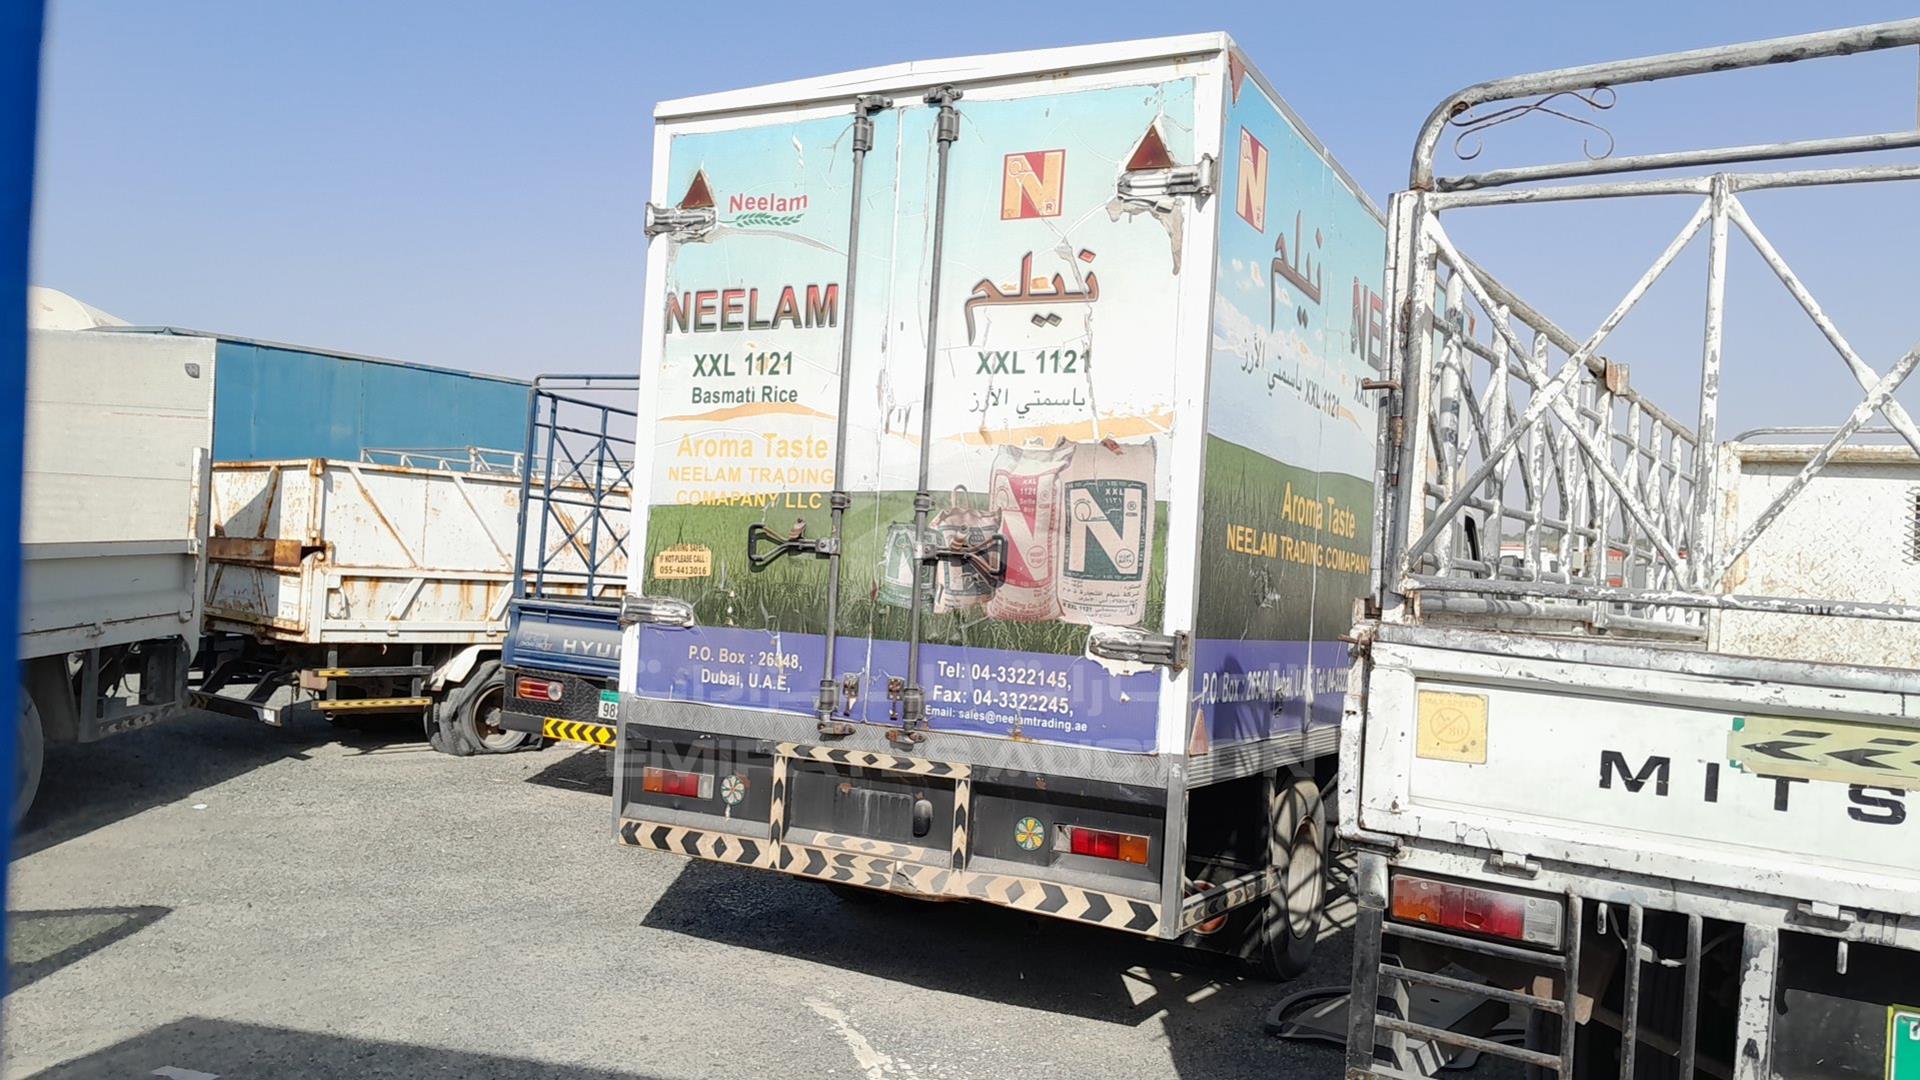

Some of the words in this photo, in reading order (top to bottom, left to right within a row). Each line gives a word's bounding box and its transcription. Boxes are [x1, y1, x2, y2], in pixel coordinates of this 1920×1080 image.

[729, 193, 808, 213] Neelam
[666, 283, 839, 334] NEELAM
[692, 353, 735, 377] XXL
[745, 351, 792, 375] 1121
[976, 351, 1025, 374] XXL
[1036, 349, 1090, 373] 1121
[692, 386, 755, 404] Basmati
[762, 386, 798, 403] Rice
[1016, 387, 1085, 419] باسمتي
[677, 434, 752, 459] Aroma
[763, 433, 828, 460] Taste
[669, 466, 741, 482] NEELAM
[749, 467, 834, 484] TRADING
[676, 490, 779, 507] COMAPANY
[785, 493, 822, 509] LLC
[1282, 481, 1323, 530] Aroma
[1327, 496, 1356, 539] Taste
[1227, 523, 1278, 558] NEELAM
[1280, 535, 1323, 567] TRADING
[1326, 546, 1371, 576] COMAPANY
[660, 566, 707, 575] 055-4413016
[688, 646, 714, 661] P.O.
[719, 648, 745, 664] Box
[701, 669, 744, 688] Dubai,
[937, 661, 965, 678] Tel:
[971, 664, 1071, 691] 04-3322145,
[1201, 672, 1219, 704] P.O.
[1222, 672, 1240, 702] Box
[925, 705, 956, 718] Email:
[933, 685, 966, 703] Fax:
[973, 689, 1074, 717] 04-3322245,
[1599, 749, 1907, 825] MITS
